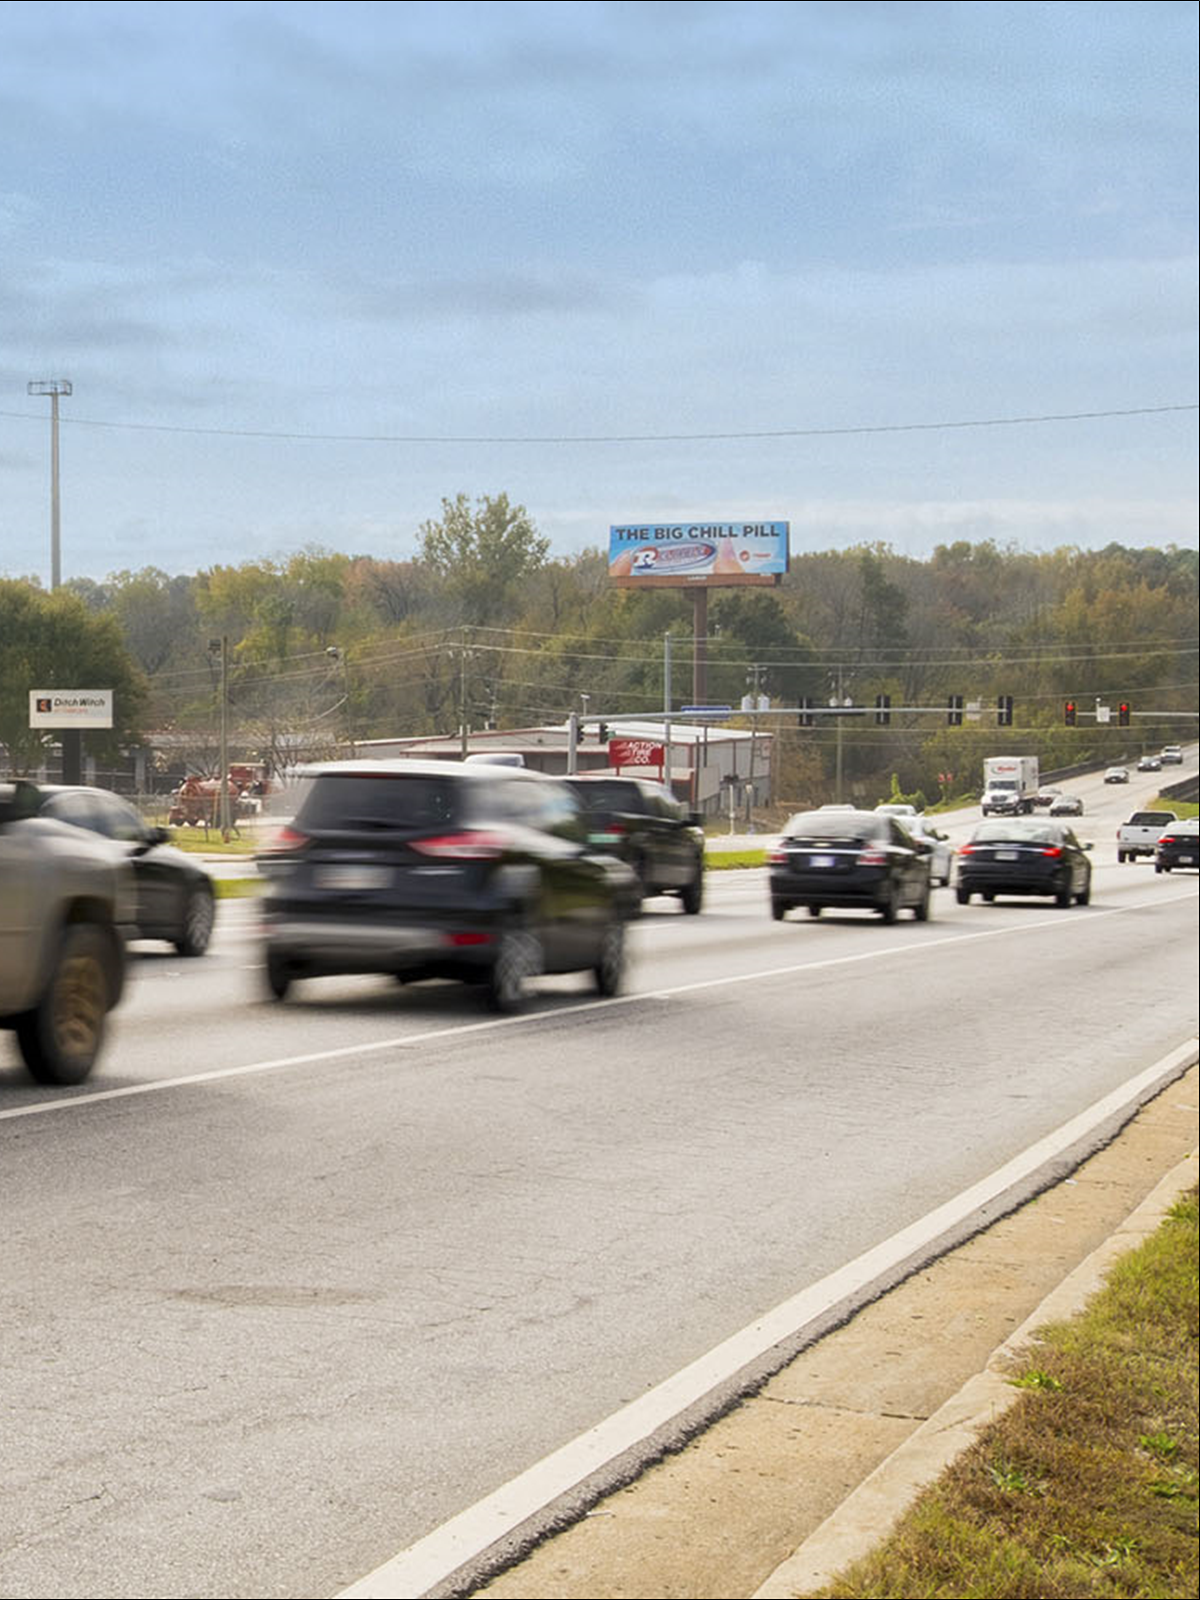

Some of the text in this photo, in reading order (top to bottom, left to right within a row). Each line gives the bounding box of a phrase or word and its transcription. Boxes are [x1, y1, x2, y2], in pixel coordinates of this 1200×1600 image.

[616, 524, 780, 541] THE BIG CHILL PILL
[628, 741, 663, 750] ACTION
